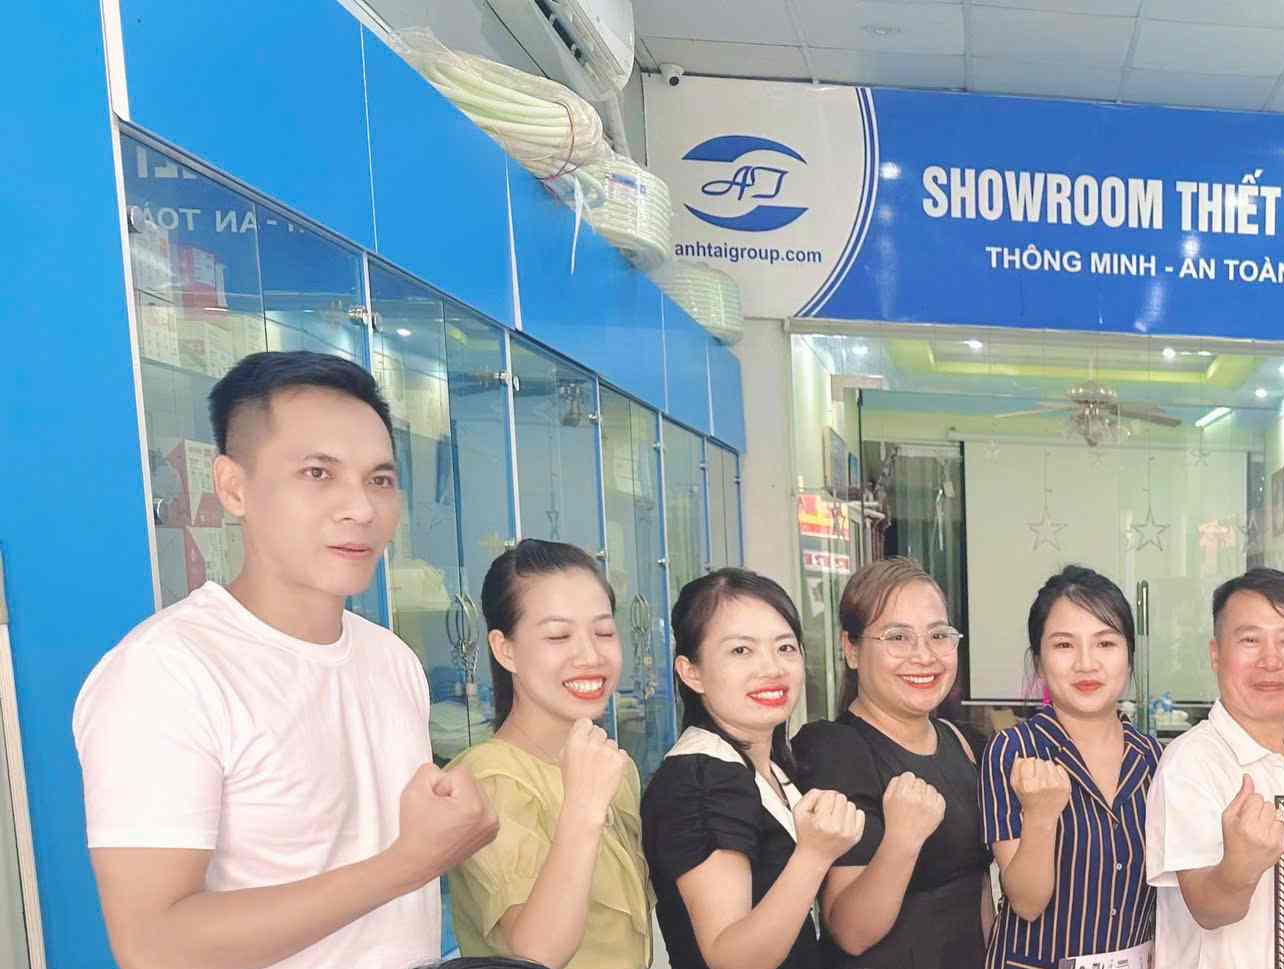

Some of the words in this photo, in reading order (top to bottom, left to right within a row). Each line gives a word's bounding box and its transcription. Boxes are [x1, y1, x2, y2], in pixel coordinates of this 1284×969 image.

[922, 165, 1163, 230] SHOWROOM
[1176, 168, 1281, 236] THIẾT
[674, 241, 822, 263] anhtaigroup.com
[985, 243, 1082, 273] THÔNG
[1090, 251, 1157, 276] MINH
[1179, 257, 1216, 279] AN
